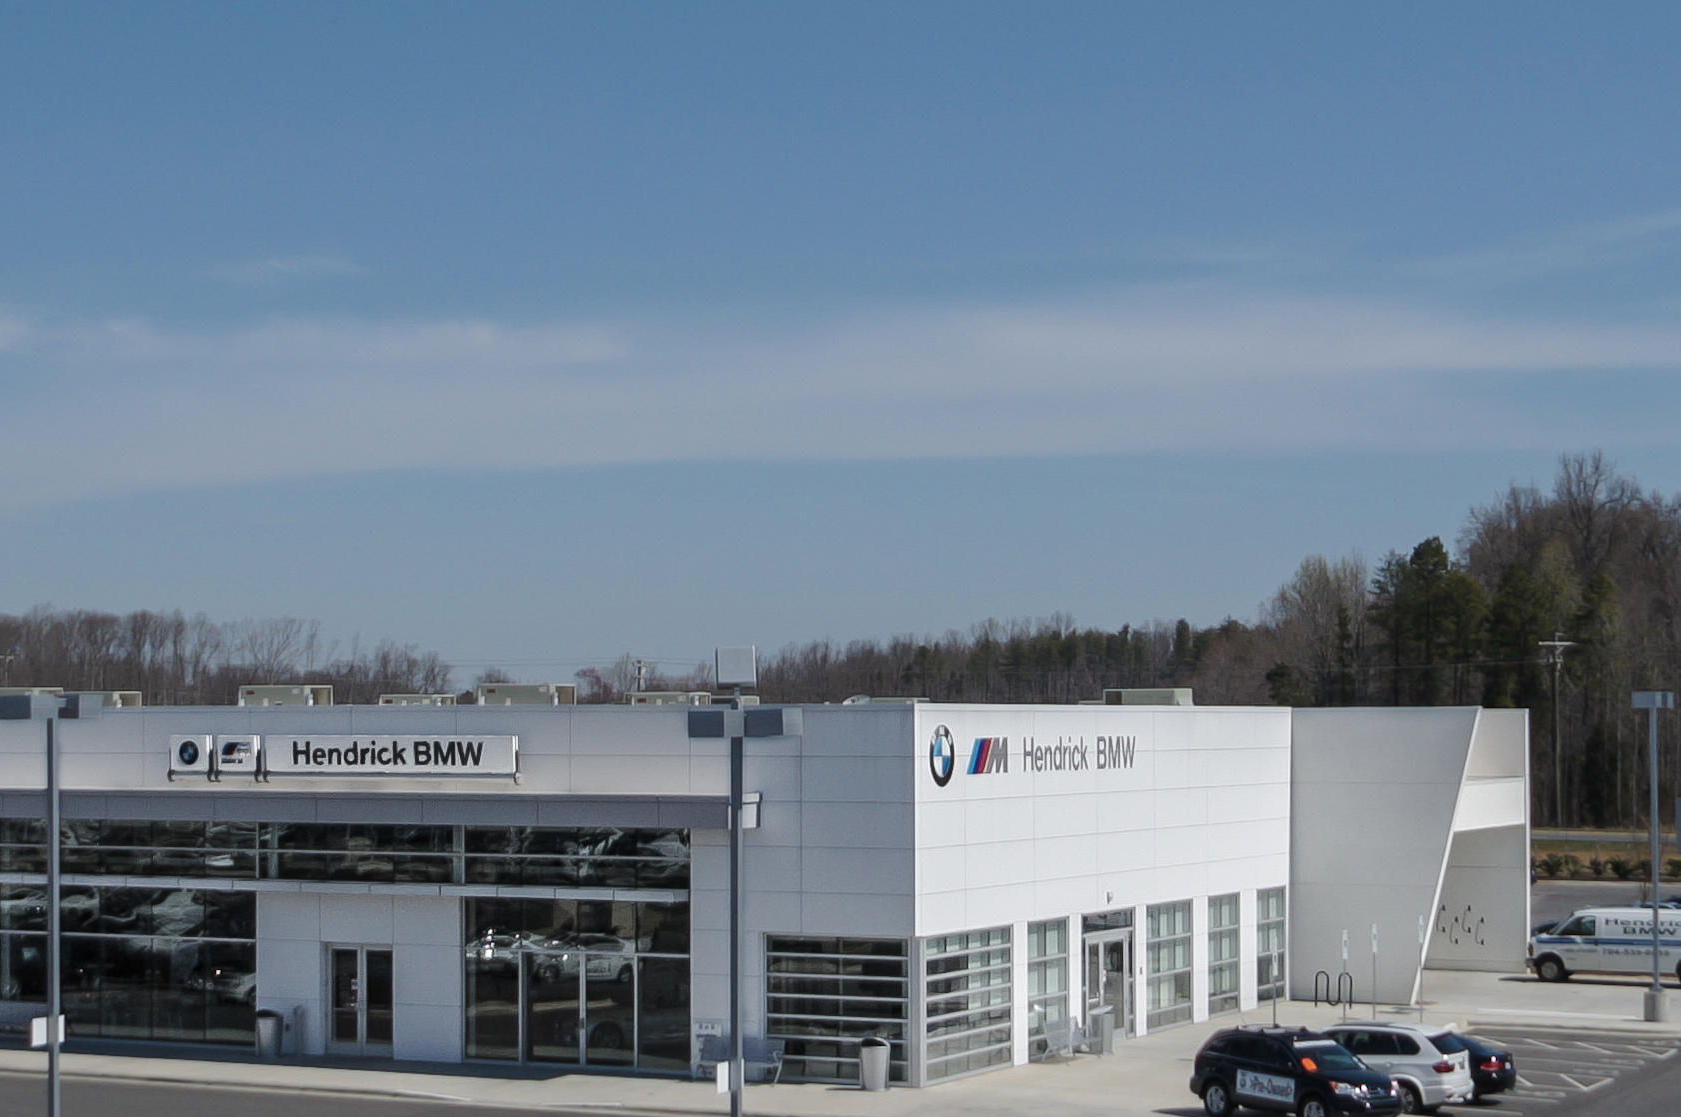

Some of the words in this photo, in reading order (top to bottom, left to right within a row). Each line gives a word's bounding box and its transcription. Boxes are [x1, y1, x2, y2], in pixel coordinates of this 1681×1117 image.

[292, 740, 407, 766] Hendrick
[413, 741, 484, 766] BMW
[1023, 736, 1088, 772] Hendrick
[1097, 736, 1136, 769] BMW
[1623, 927, 1677, 936] BMW
